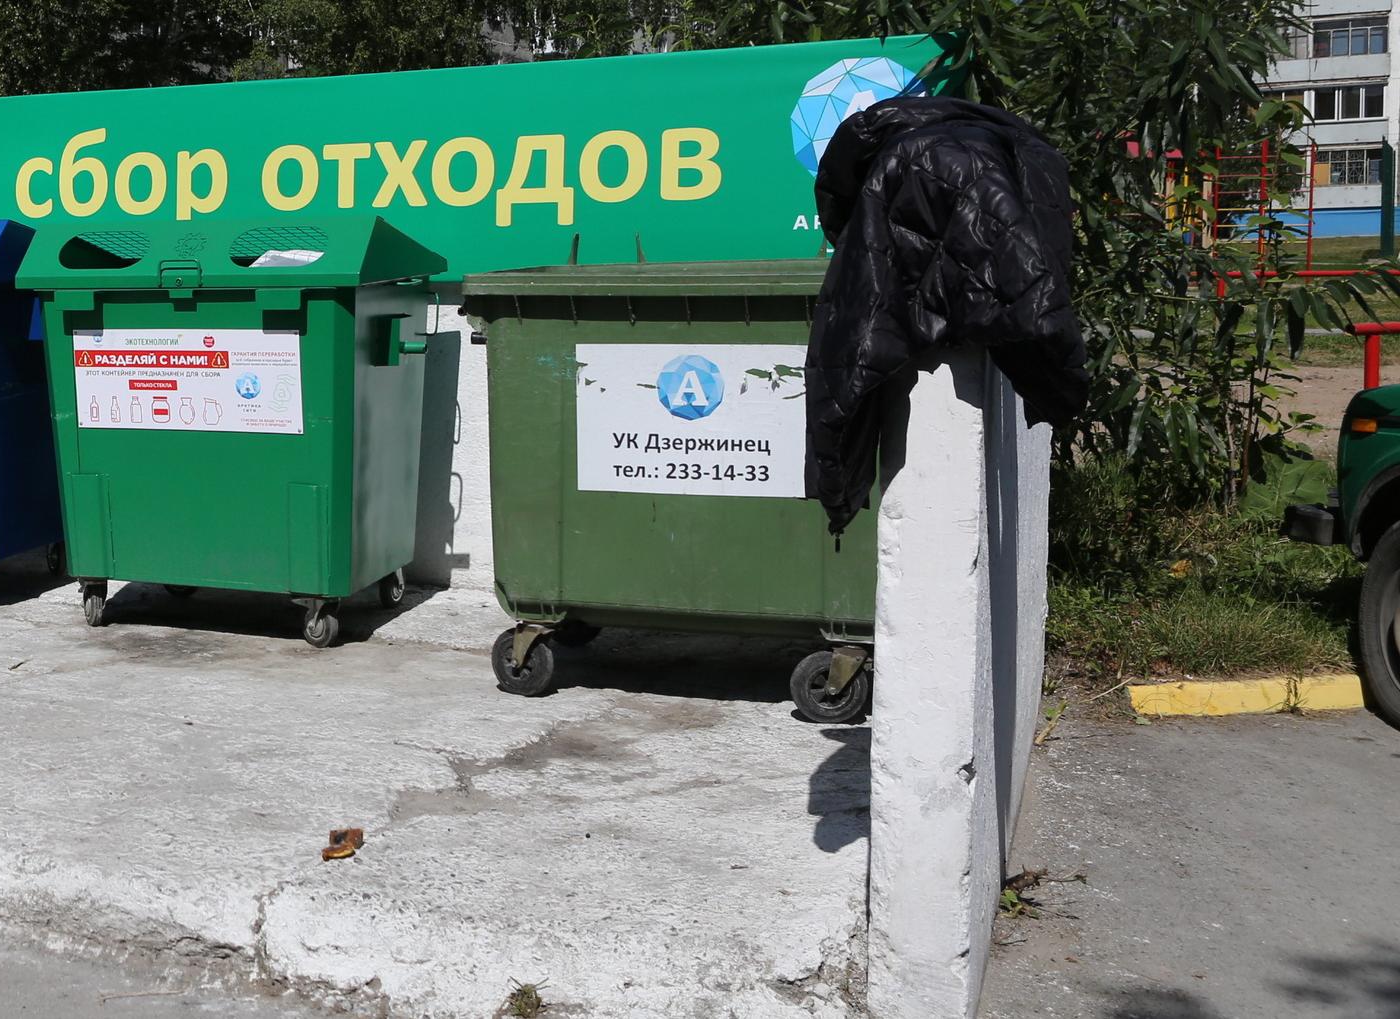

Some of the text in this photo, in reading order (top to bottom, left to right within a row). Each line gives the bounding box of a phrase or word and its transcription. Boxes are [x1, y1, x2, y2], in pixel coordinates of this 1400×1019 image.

[14, 127, 229, 220] сбор
[260, 126, 723, 227] отходов
[124, 338, 179, 346] ЭКОТЕХНОЛОГИИ
[94, 353, 209, 366] РАЗДЕЛЯЙ С НАМИ!
[101, 369, 136, 377] КОНТЕЙНЕР
[138, 370, 185, 378] ПРЕДНАЗНАЧЕН
[612, 432, 771, 456] УК Дзержинец
[612, 463, 770, 482] тел.: 233-14-33
